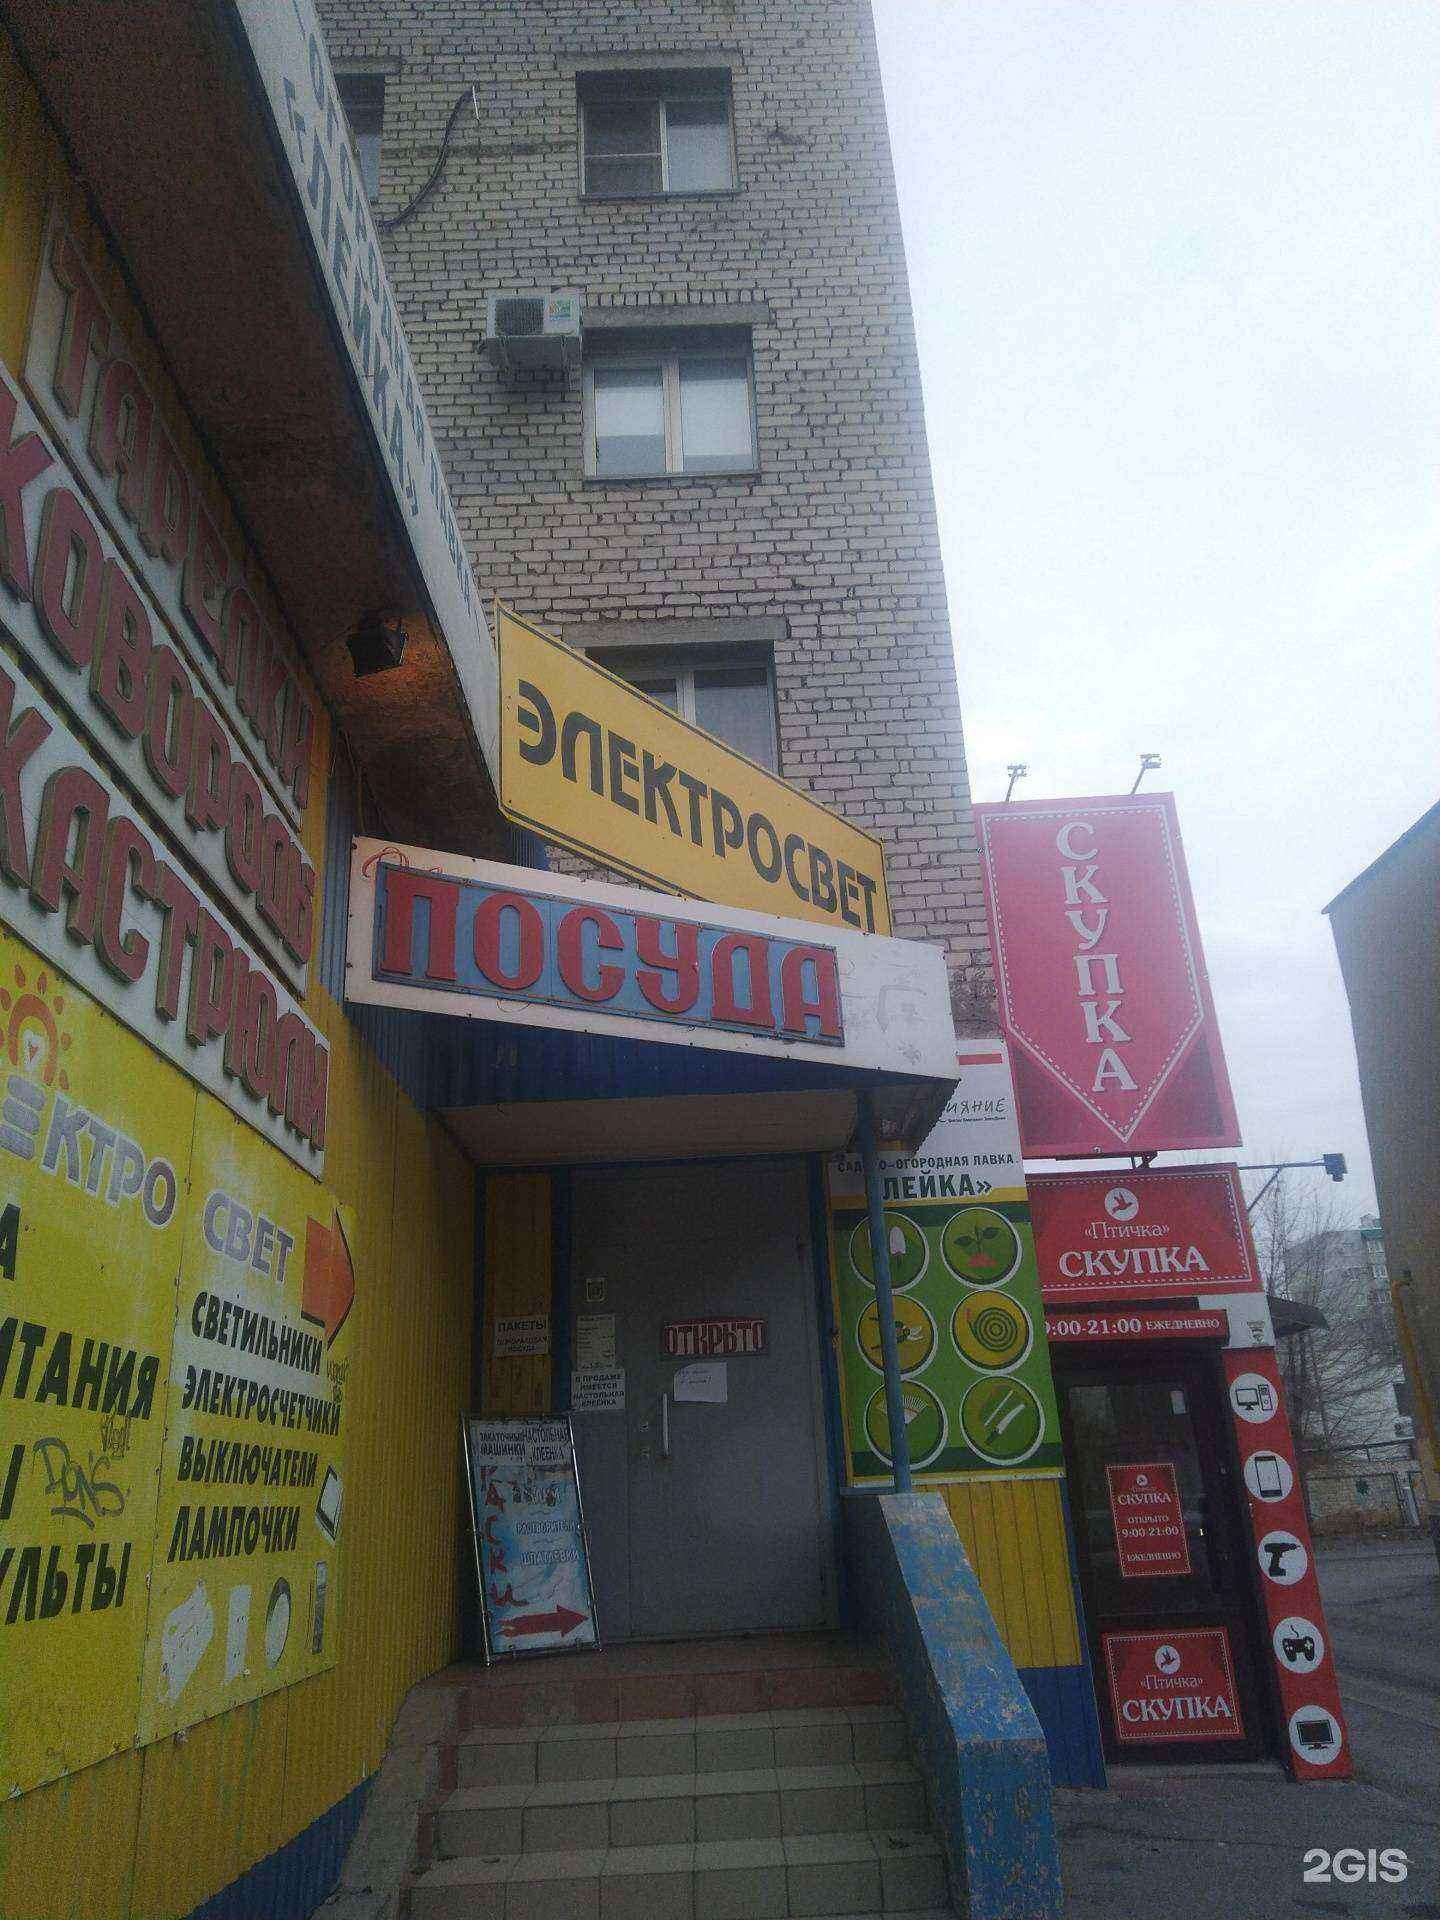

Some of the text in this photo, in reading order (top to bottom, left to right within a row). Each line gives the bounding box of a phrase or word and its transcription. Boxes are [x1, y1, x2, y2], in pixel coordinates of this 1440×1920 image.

[517, 678, 878, 936] ЭЛЕКТРОСВЕТ
[380, 868, 842, 1042] ПОСУДА
[1055, 820, 1139, 1093] СКУПКА
[946, 1097, 1006, 1116] ИЯНИЕ
[973, 1153, 1014, 1166] ЛАВКА
[882, 1169, 993, 1200] ЛЕЙКА»
[203, 1191, 295, 1283] СВЕТ
[1084, 1221, 1170, 1240] «Птичка»
[1059, 1246, 1211, 1278] СКУПКА
[191, 1291, 323, 1376] СВЕТИЛЬНИКИ
[497, 1319, 547, 1332] ПАКЕТЫ
[664, 1321, 768, 1354] ОТКРЫТО
[1146, 1317, 1220, 1332] ЕЖЕДНЕВНО
[182, 1364, 341, 1437] ЭЛЕКТРОСЧЕТЧИКИ
[177, 1436, 319, 1488] ВЫКЛЮЧАТЕЛИ
[1117, 1492, 1172, 1506] СКУПКА
[167, 1505, 301, 1563] ЛАМПОЧКИ
[1122, 1696, 1232, 1722] СКУПКА
